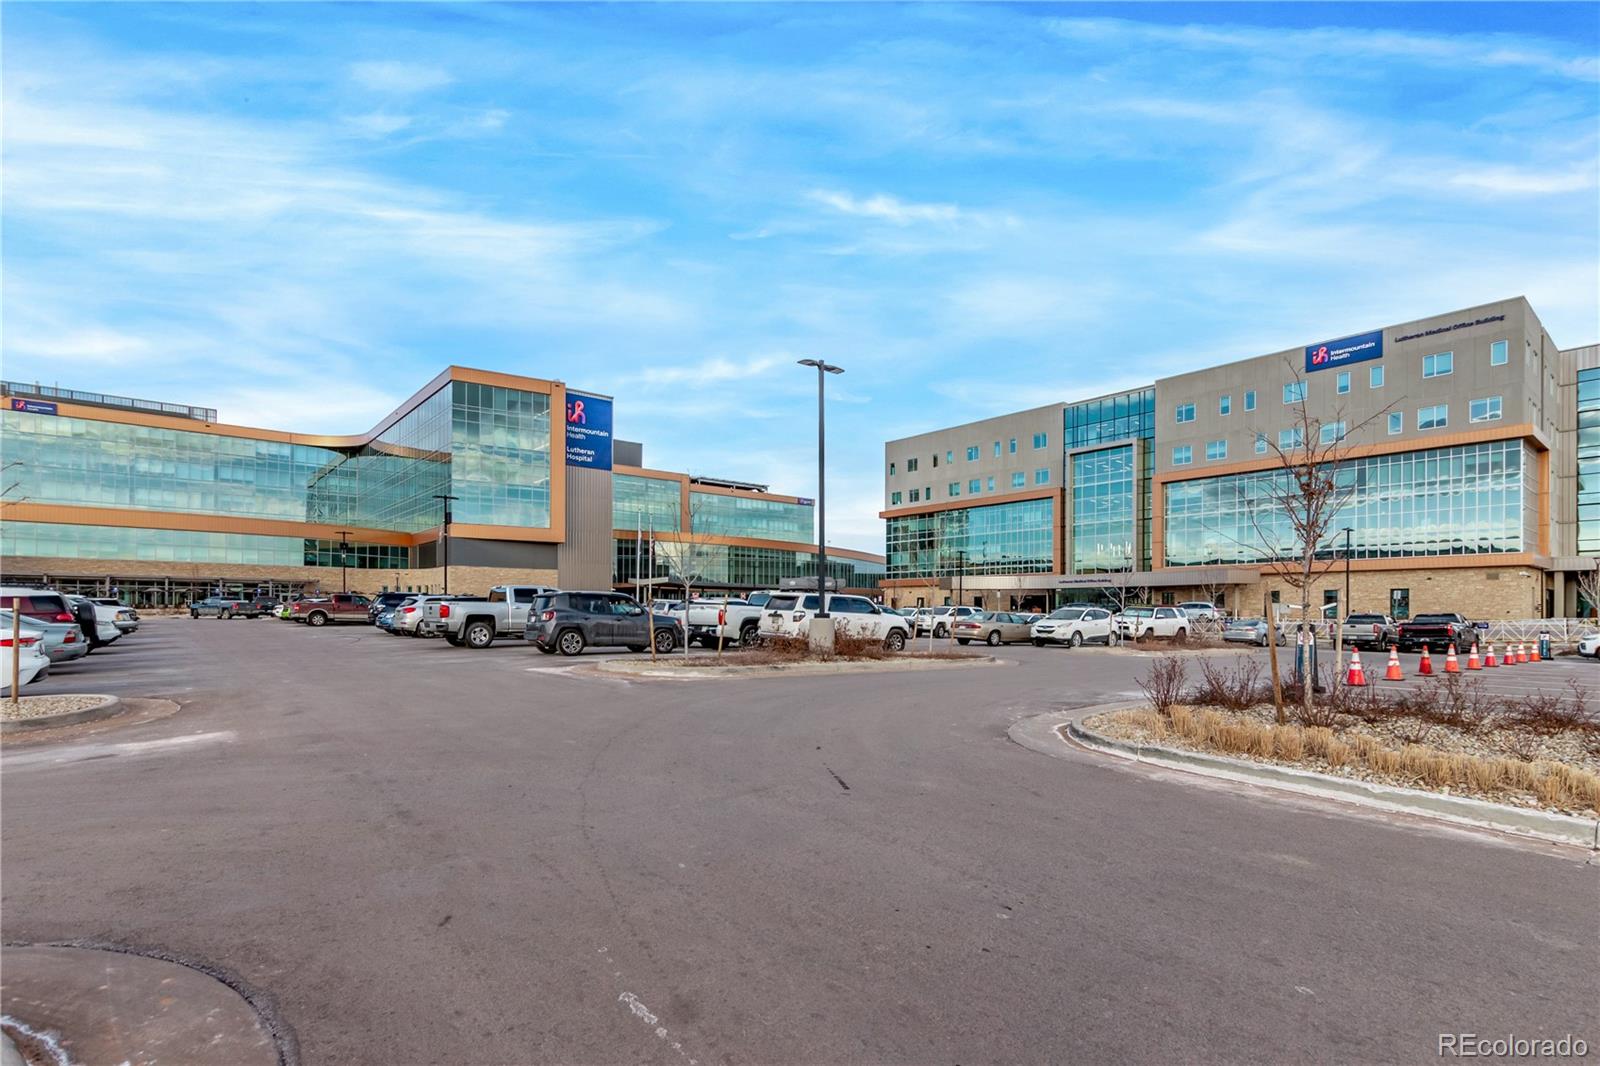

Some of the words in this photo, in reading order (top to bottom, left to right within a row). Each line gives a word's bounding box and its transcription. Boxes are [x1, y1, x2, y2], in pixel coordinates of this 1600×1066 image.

[1395, 332, 1424, 343] Lutheran
[1425, 326, 1452, 336] Medical
[1453, 321, 1474, 330] Office
[1475, 315, 1505, 325] Building
[1330, 341, 1376, 355] Intermountain
[1330, 353, 1350, 361] Health
[566, 425, 609, 437] Intermountain
[566, 432, 586, 440] Health
[566, 446, 595, 456] Lutheran
[566, 454, 593, 462] Hospital
